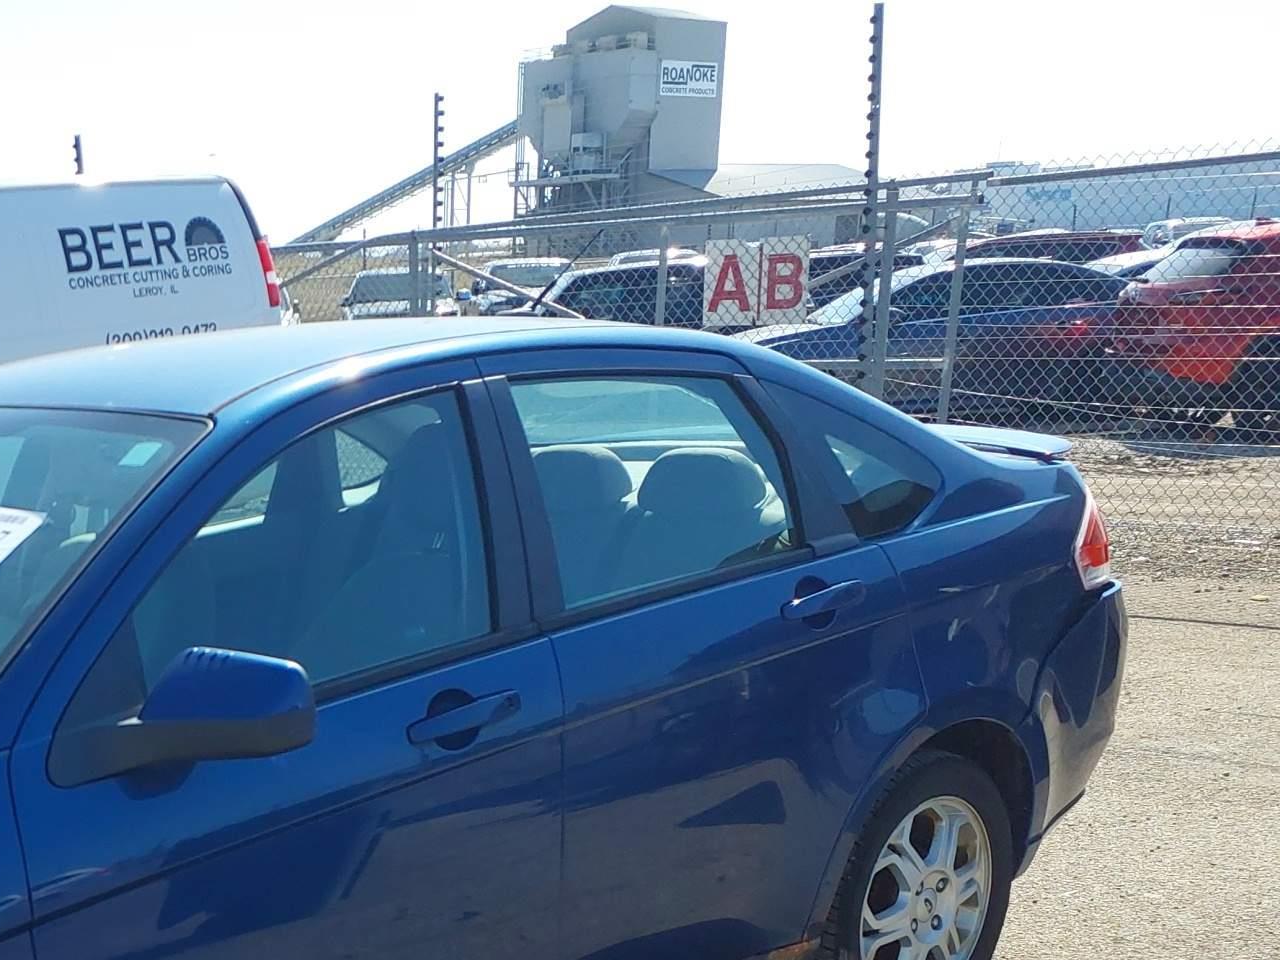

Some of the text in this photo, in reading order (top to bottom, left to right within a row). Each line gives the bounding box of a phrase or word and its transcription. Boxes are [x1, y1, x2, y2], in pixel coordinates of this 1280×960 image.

[662, 65, 716, 83] ROANOKE
[57, 220, 182, 273] BEER
[186, 245, 229, 262] BROS
[68, 262, 233, 290] CONCRETE CUTTING & CORING
